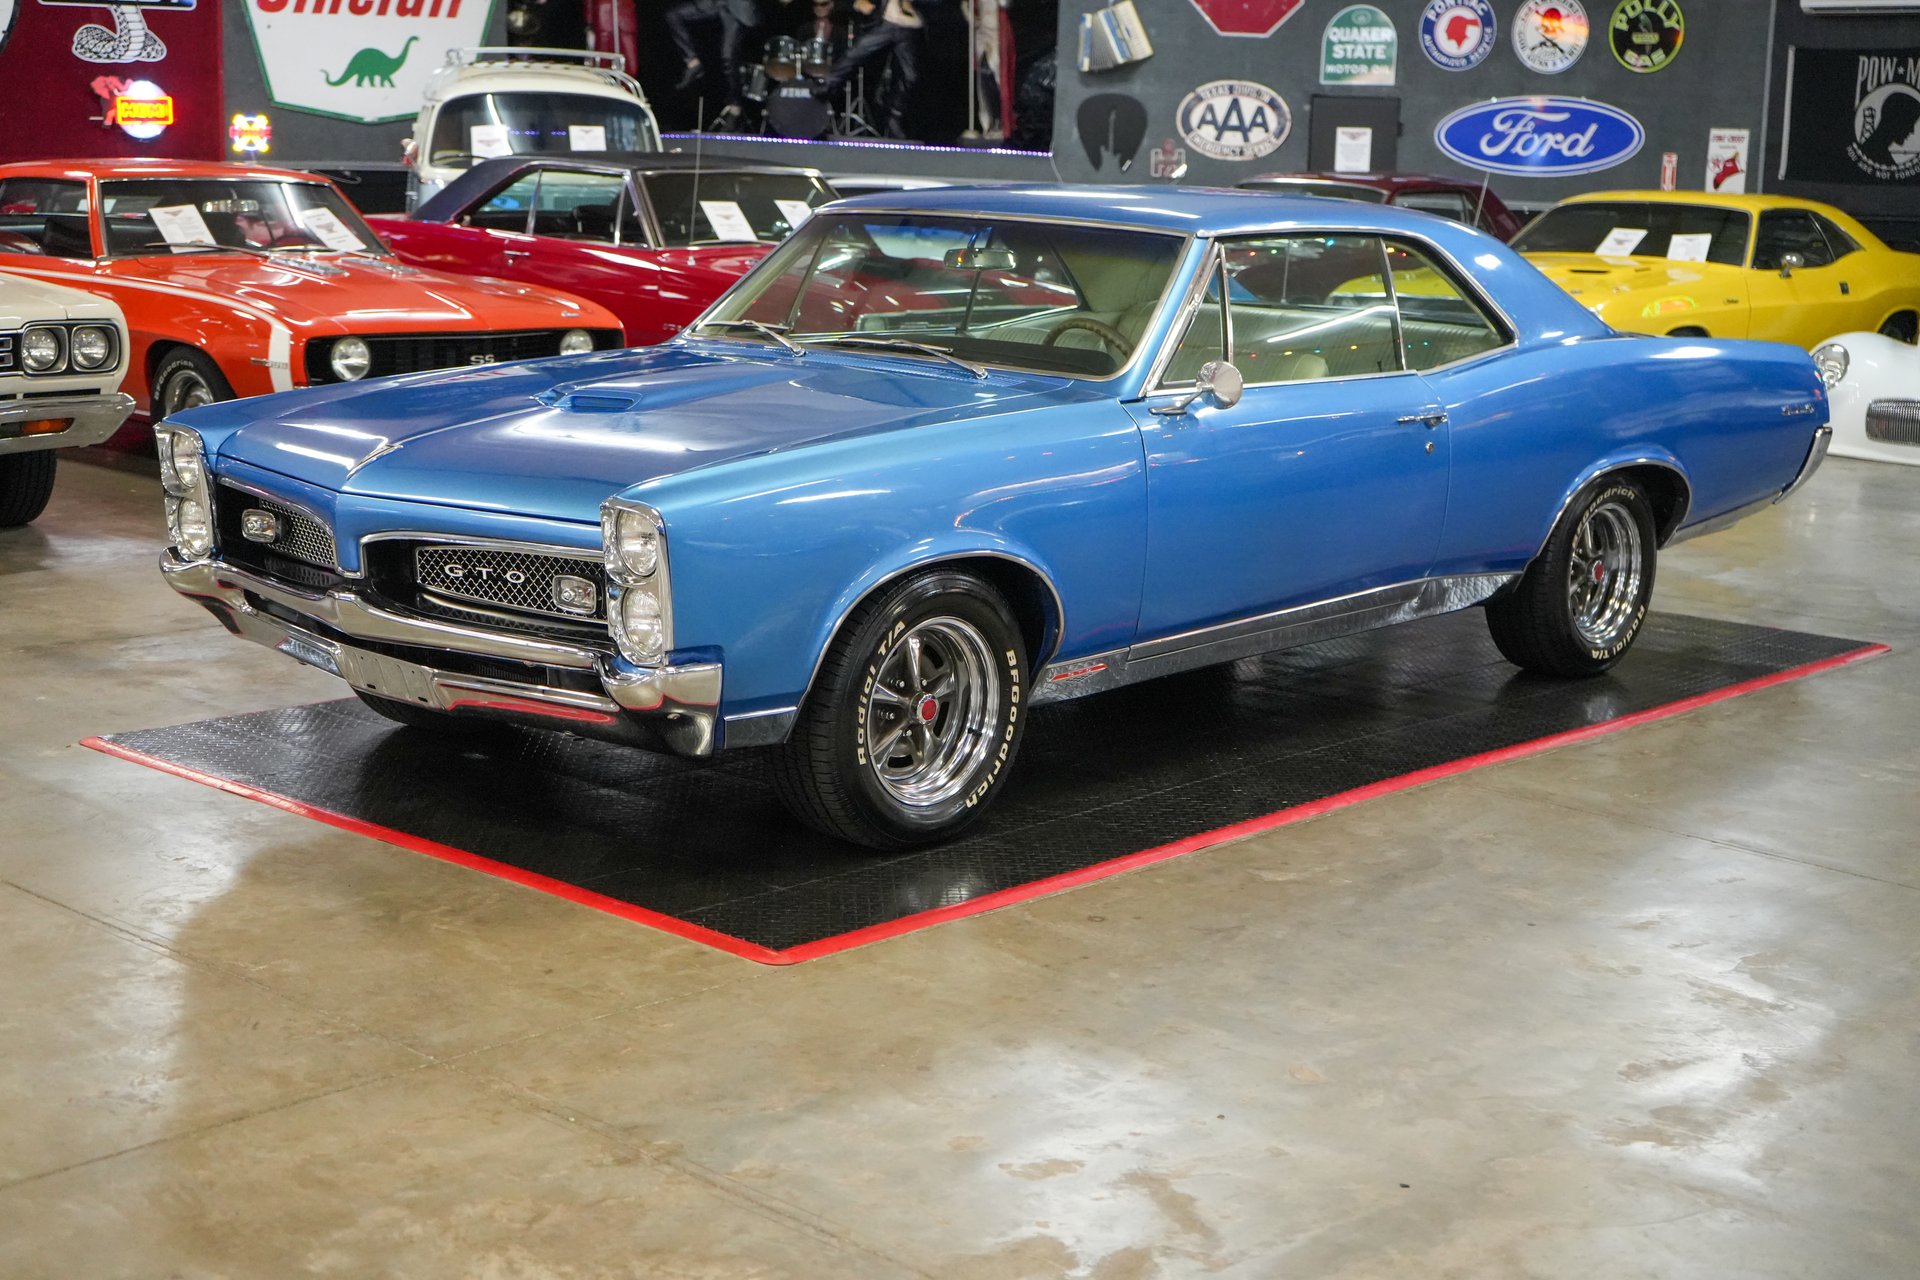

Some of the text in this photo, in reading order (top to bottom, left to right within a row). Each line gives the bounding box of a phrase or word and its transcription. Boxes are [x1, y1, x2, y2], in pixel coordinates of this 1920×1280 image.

[1615, 0, 1680, 31] POLLY
[1328, 26, 1394, 43] QUAKER
[1470, 26, 1492, 62] SERVICE
[1332, 43, 1386, 59] STATE
[1624, 47, 1666, 67] GAS
[1325, 63, 1390, 75] MOTOR OIL
[1197, 97, 1269, 142] AAA
[1479, 109, 1599, 157] Ford
[1875, 169, 1891, 181] NOT
[470, 354, 496, 366] SS
[444, 563, 526, 584] GTO
[877, 620, 906, 657] T/A
[857, 665, 877, 766] Radial
[965, 649, 1020, 808] BFGoodrich
